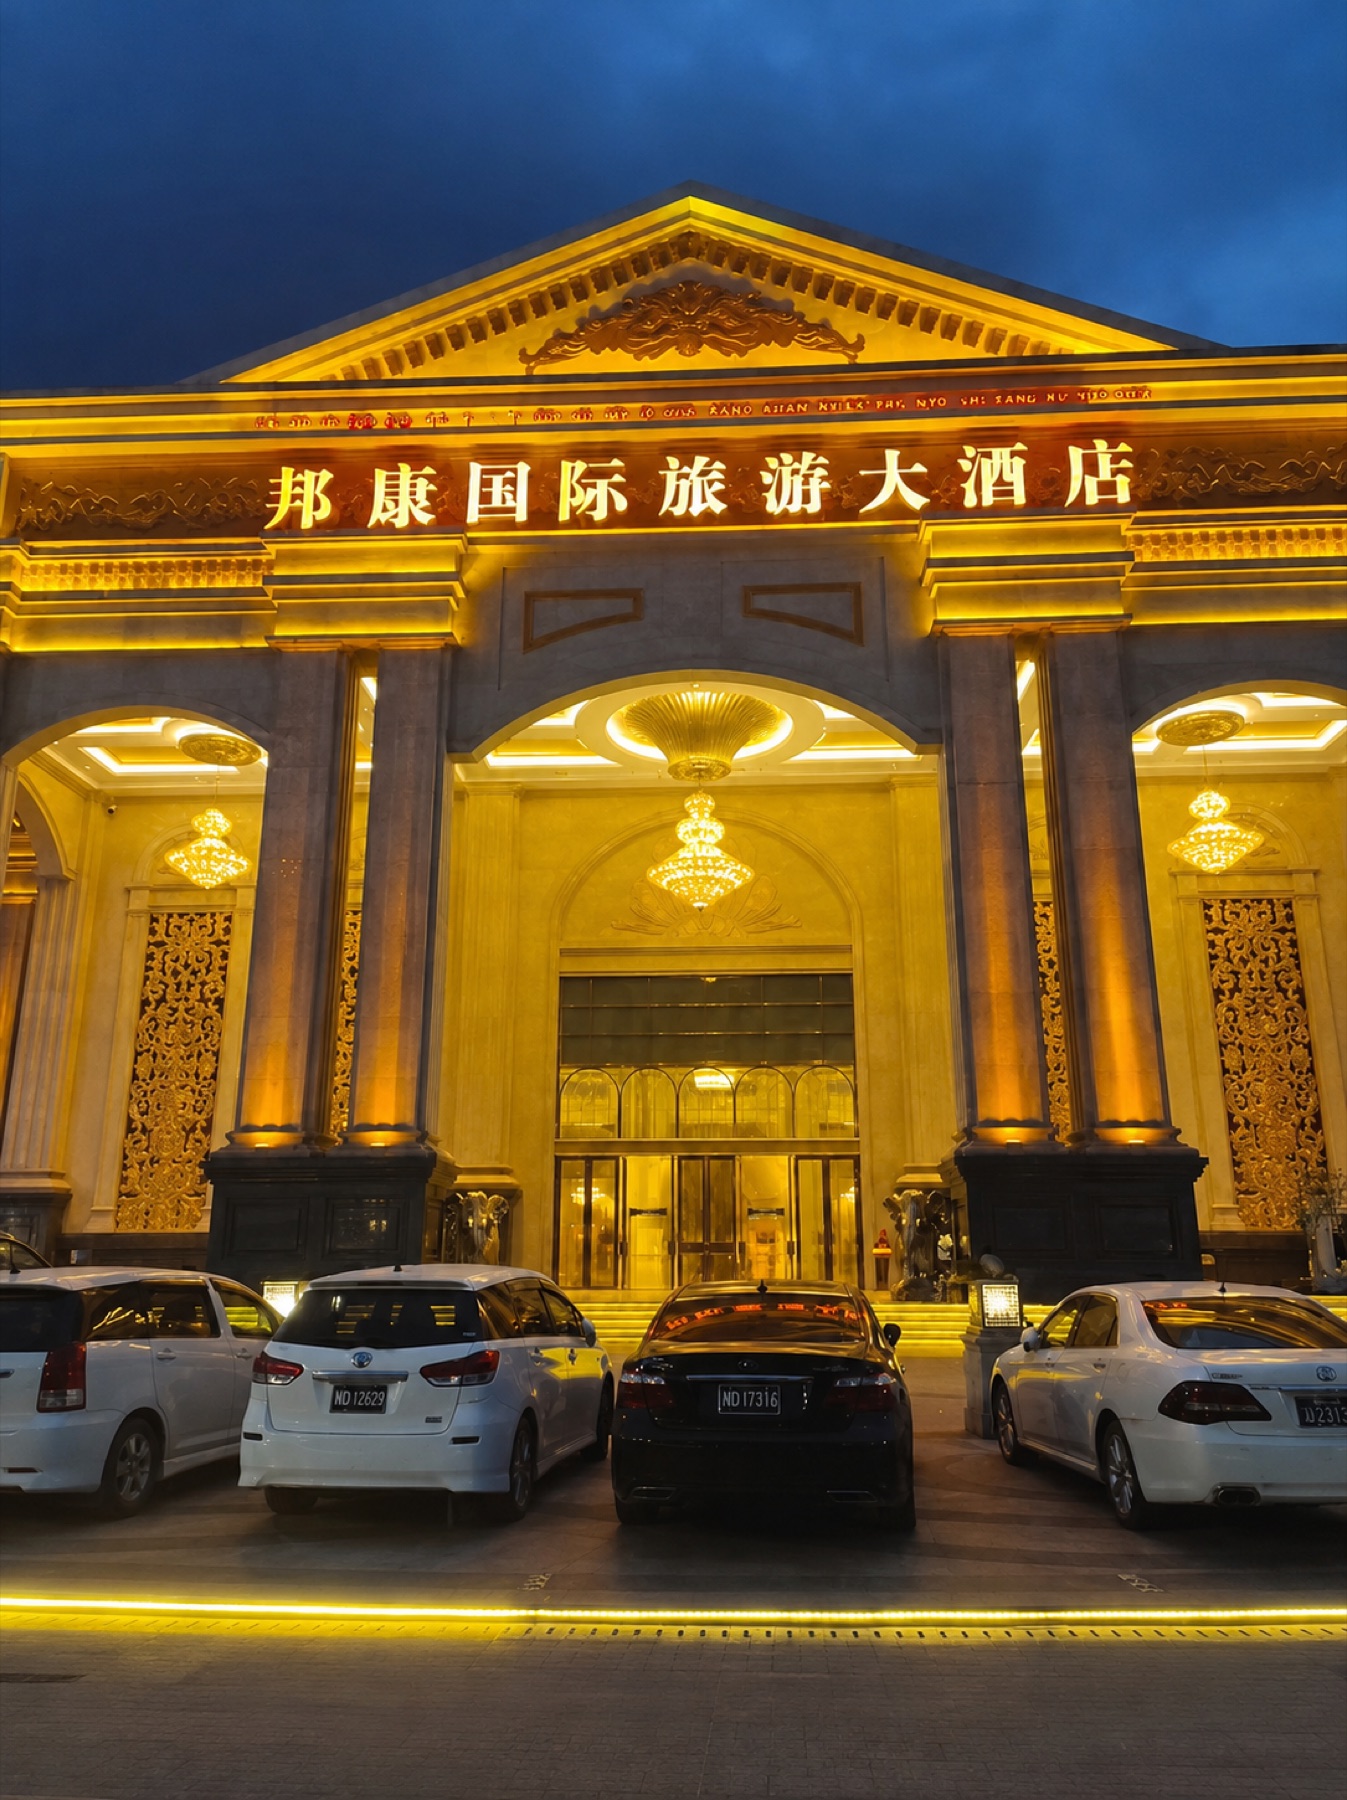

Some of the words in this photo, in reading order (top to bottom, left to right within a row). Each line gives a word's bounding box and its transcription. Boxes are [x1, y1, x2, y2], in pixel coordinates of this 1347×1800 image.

[264, 439, 1135, 530] 邦康国际旅游大酒店
